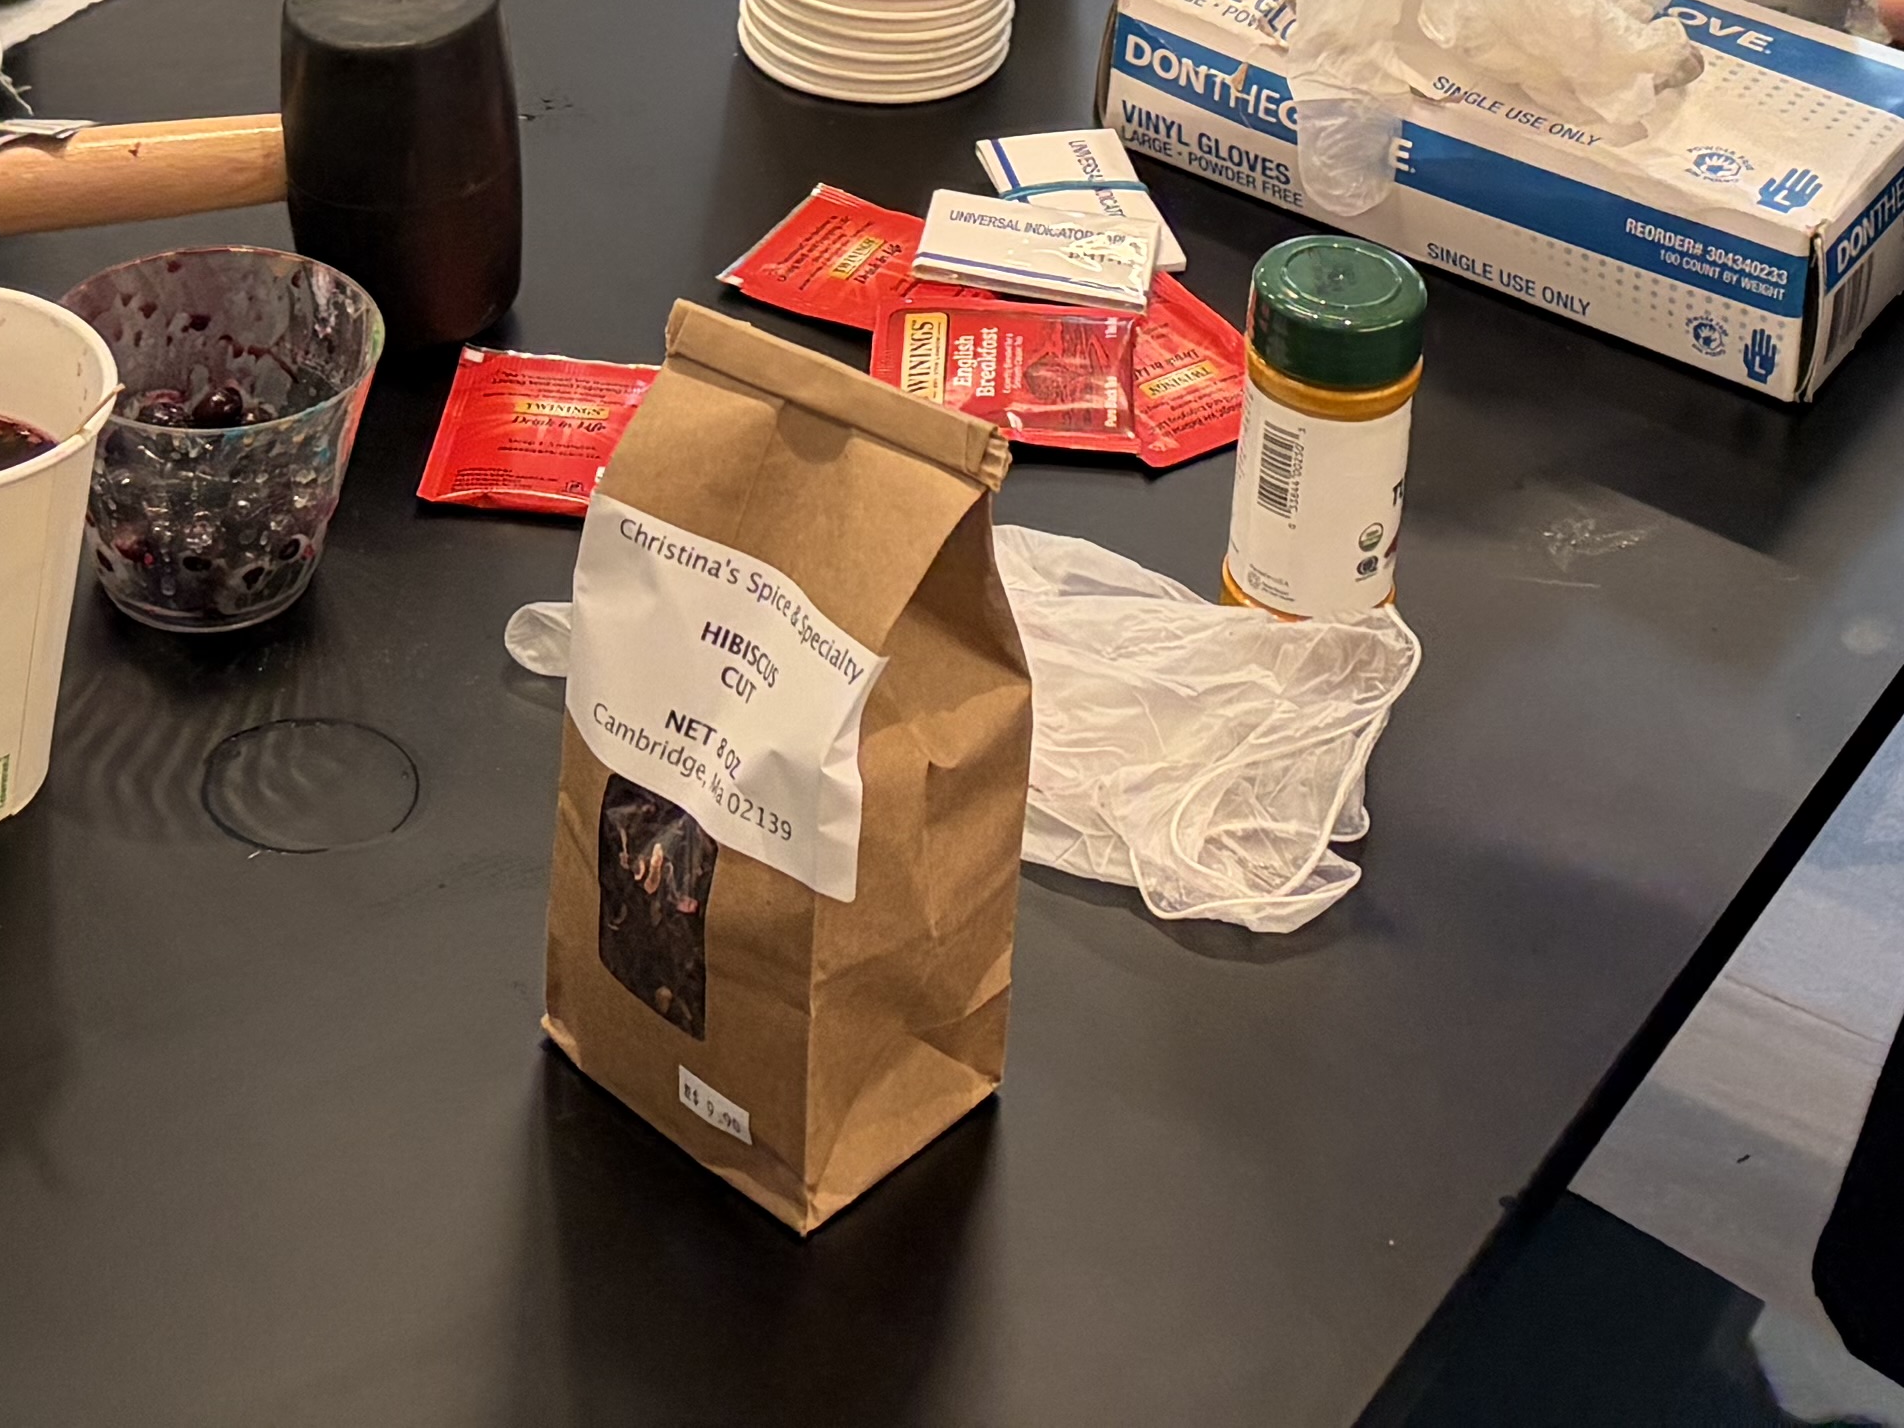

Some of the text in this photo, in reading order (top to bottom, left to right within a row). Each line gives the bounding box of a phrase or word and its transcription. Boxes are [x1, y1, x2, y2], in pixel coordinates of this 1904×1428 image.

[1122, 100, 1292, 185] VINYL GLOVES
[1432, 75, 1602, 147] SINGLE USE ONLY
[1121, 126, 1304, 208] LARGE POWDER FREE
[949, 209, 1022, 233] UNIVERSAL
[1626, 217, 1788, 285] REORDER# 304340233
[1427, 242, 1591, 317] SINGLE USE ONLY
[1659, 249, 1786, 301] 100 COUNT BY WEIGHT
[953, 335, 978, 387] English
[976, 327, 999, 397] Breakfast
[618, 517, 865, 686] Christina's Spice & Specialty
[700, 620, 780, 689] HIBISCUS
[720, 665, 757, 704] CUT
[593, 701, 707, 789] Cambridge,
[726, 793, 793, 842] 02139
[665, 708, 743, 780] NET 8 OZ
